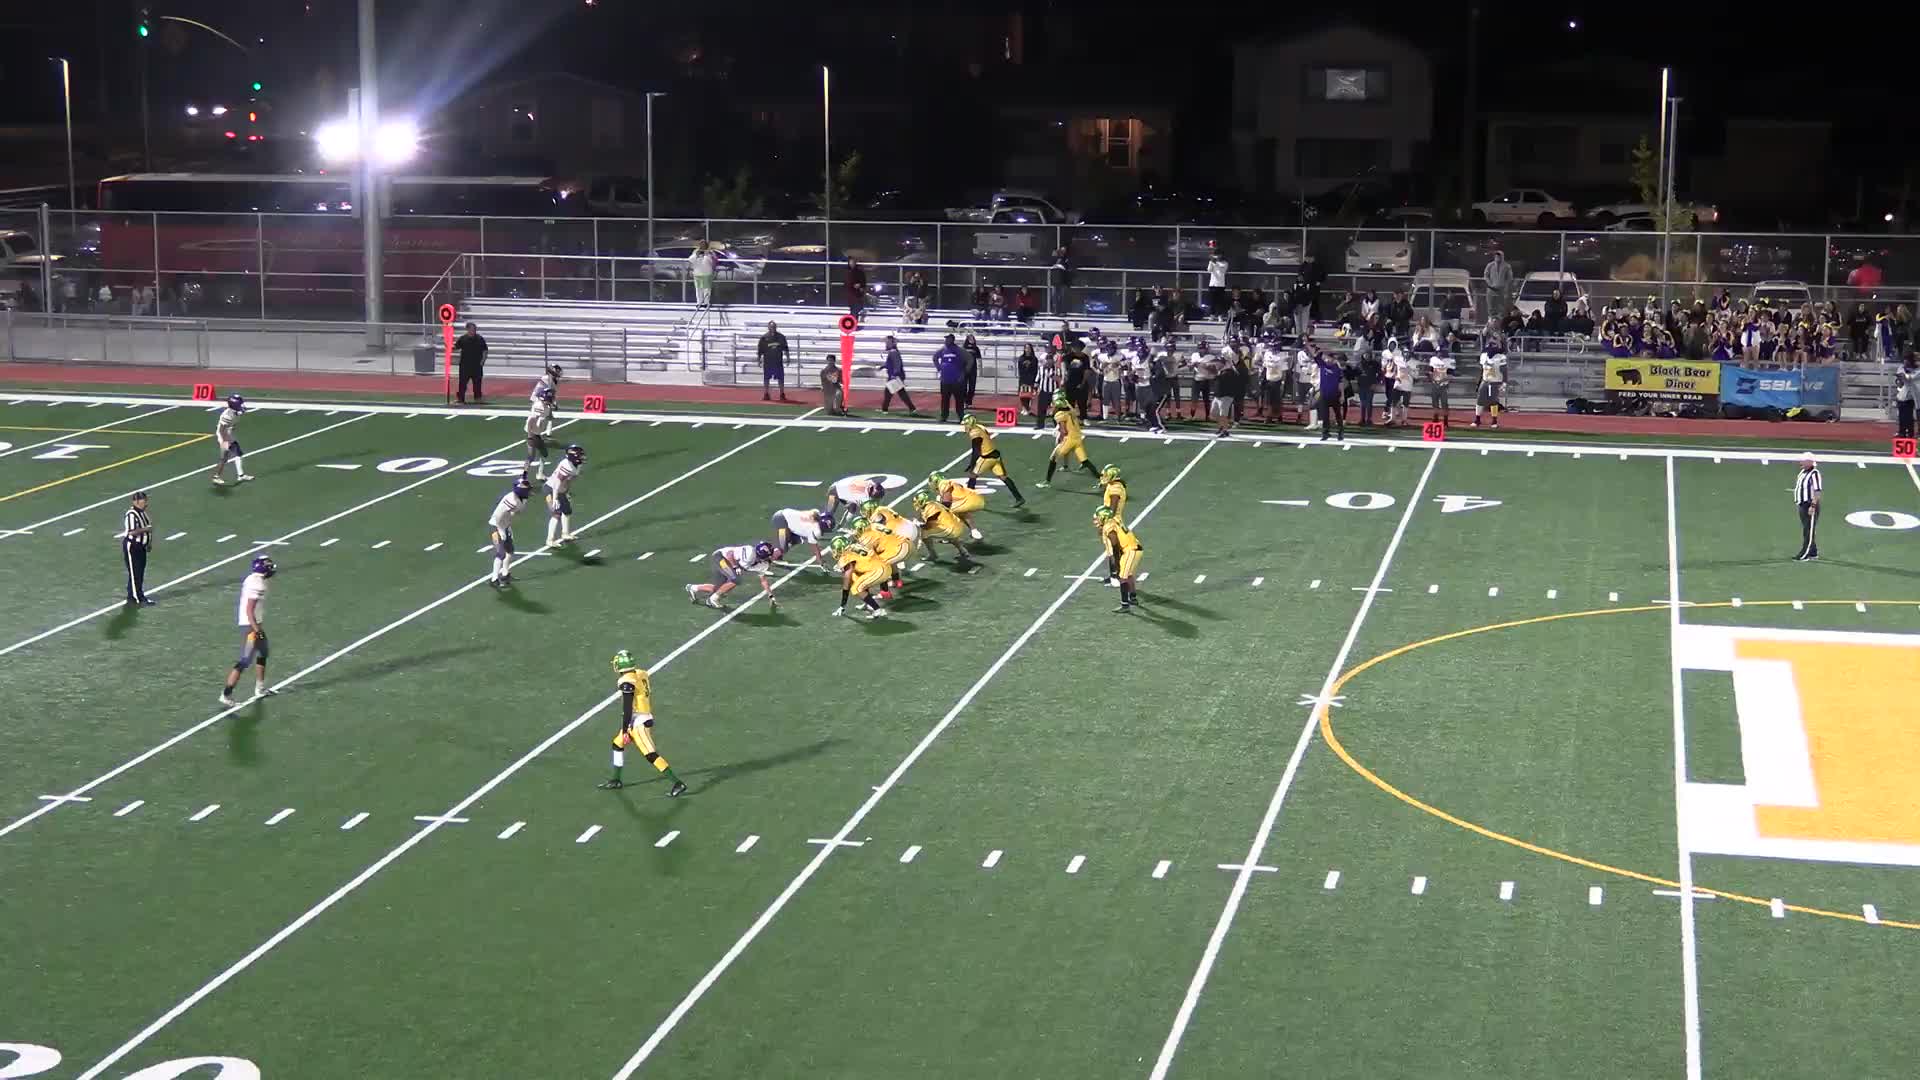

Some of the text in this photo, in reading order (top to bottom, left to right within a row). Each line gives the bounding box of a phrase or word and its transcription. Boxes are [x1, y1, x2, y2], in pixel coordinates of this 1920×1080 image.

[1052, 333, 1063, 350] 4
[1648, 364, 1713, 378] Black Bear
[1665, 378, 1696, 389] Diner
[195, 385, 209, 399] 10
[585, 397, 602, 411] 20
[997, 409, 1015, 424] 30
[1424, 423, 1443, 439] 40
[1894, 439, 1914, 455] 50
